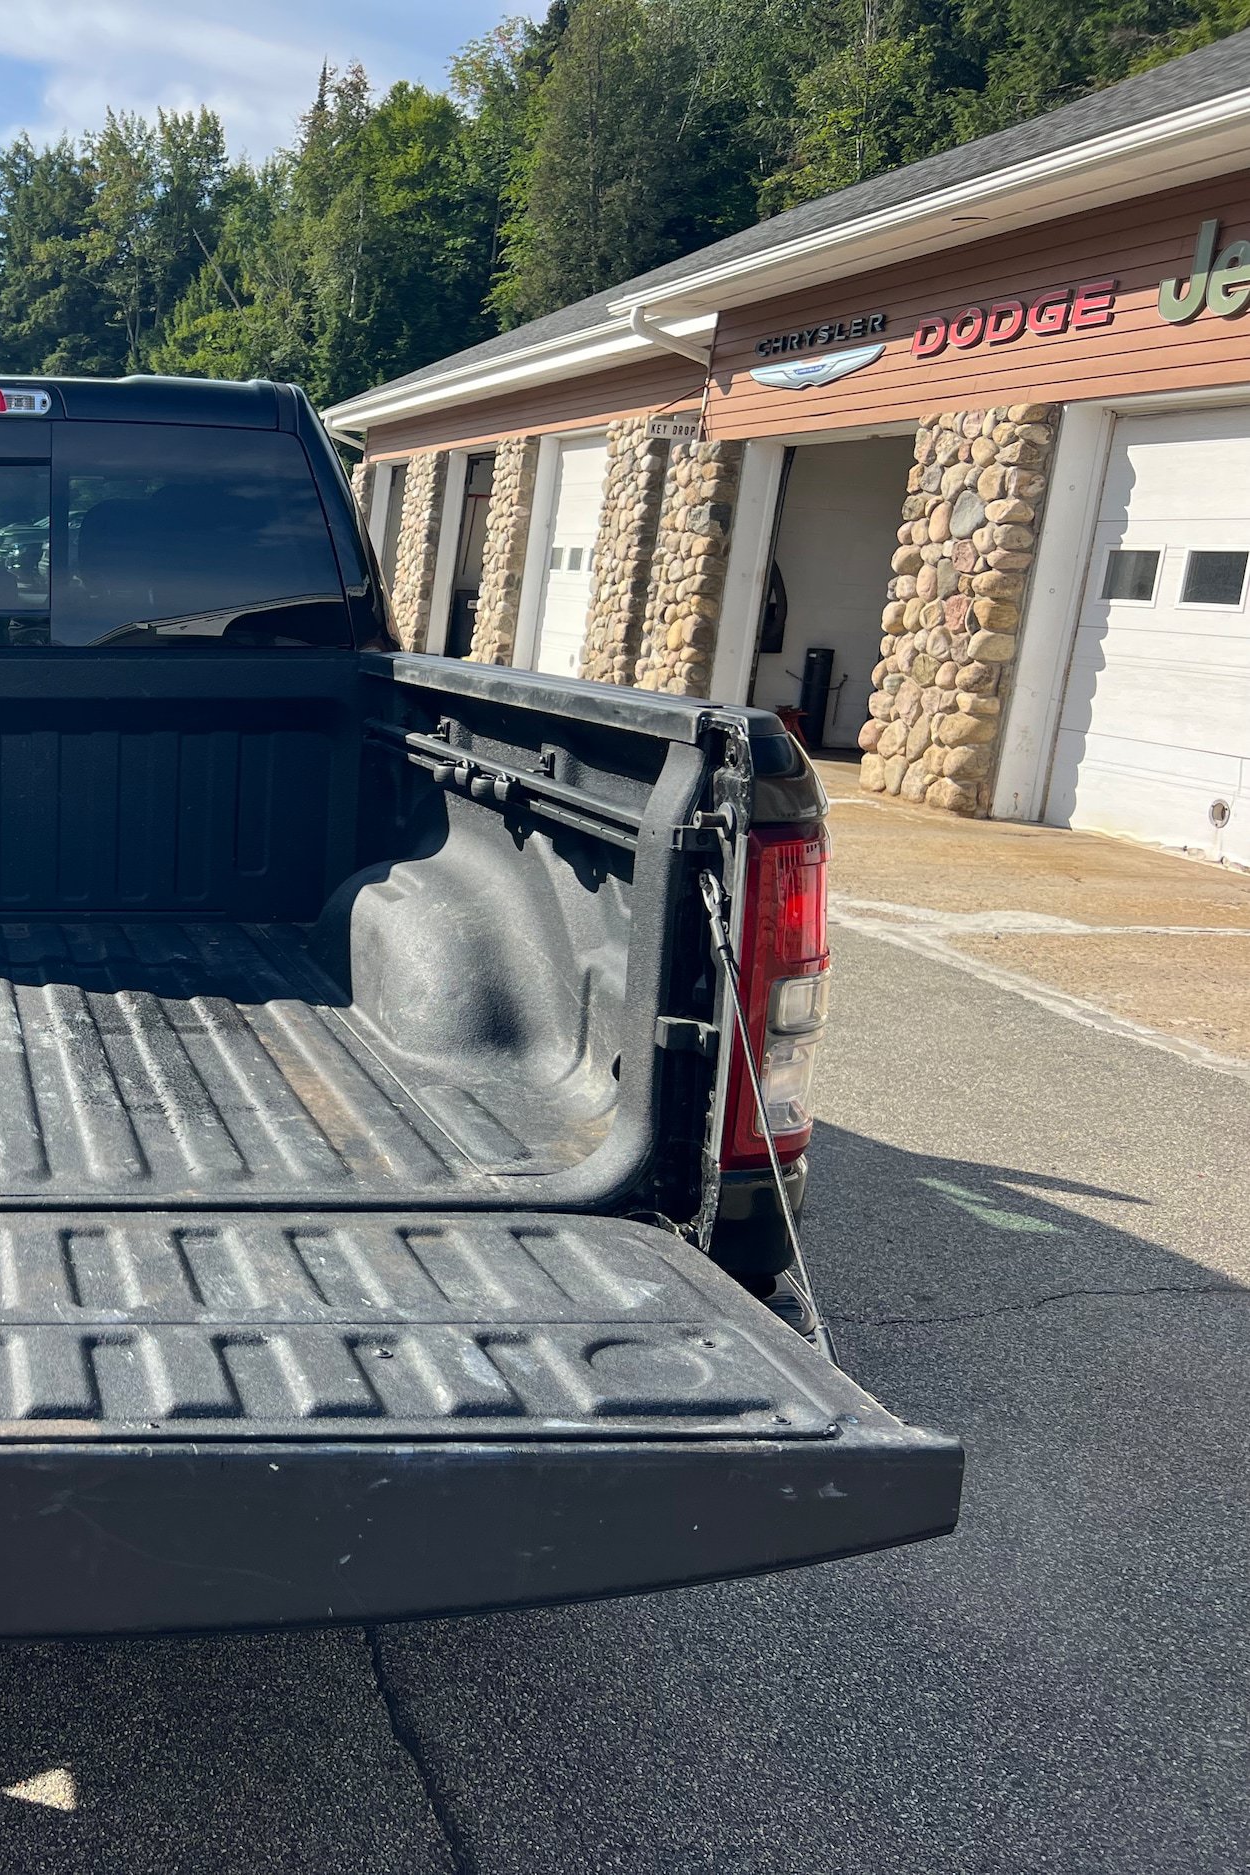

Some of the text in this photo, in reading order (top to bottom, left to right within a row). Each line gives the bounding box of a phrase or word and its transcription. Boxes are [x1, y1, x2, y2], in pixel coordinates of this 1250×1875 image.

[755, 313, 886, 357] CHRYSLER
[910, 279, 1119, 358] DODGE
[651, 423, 696, 436] KEY DROP
